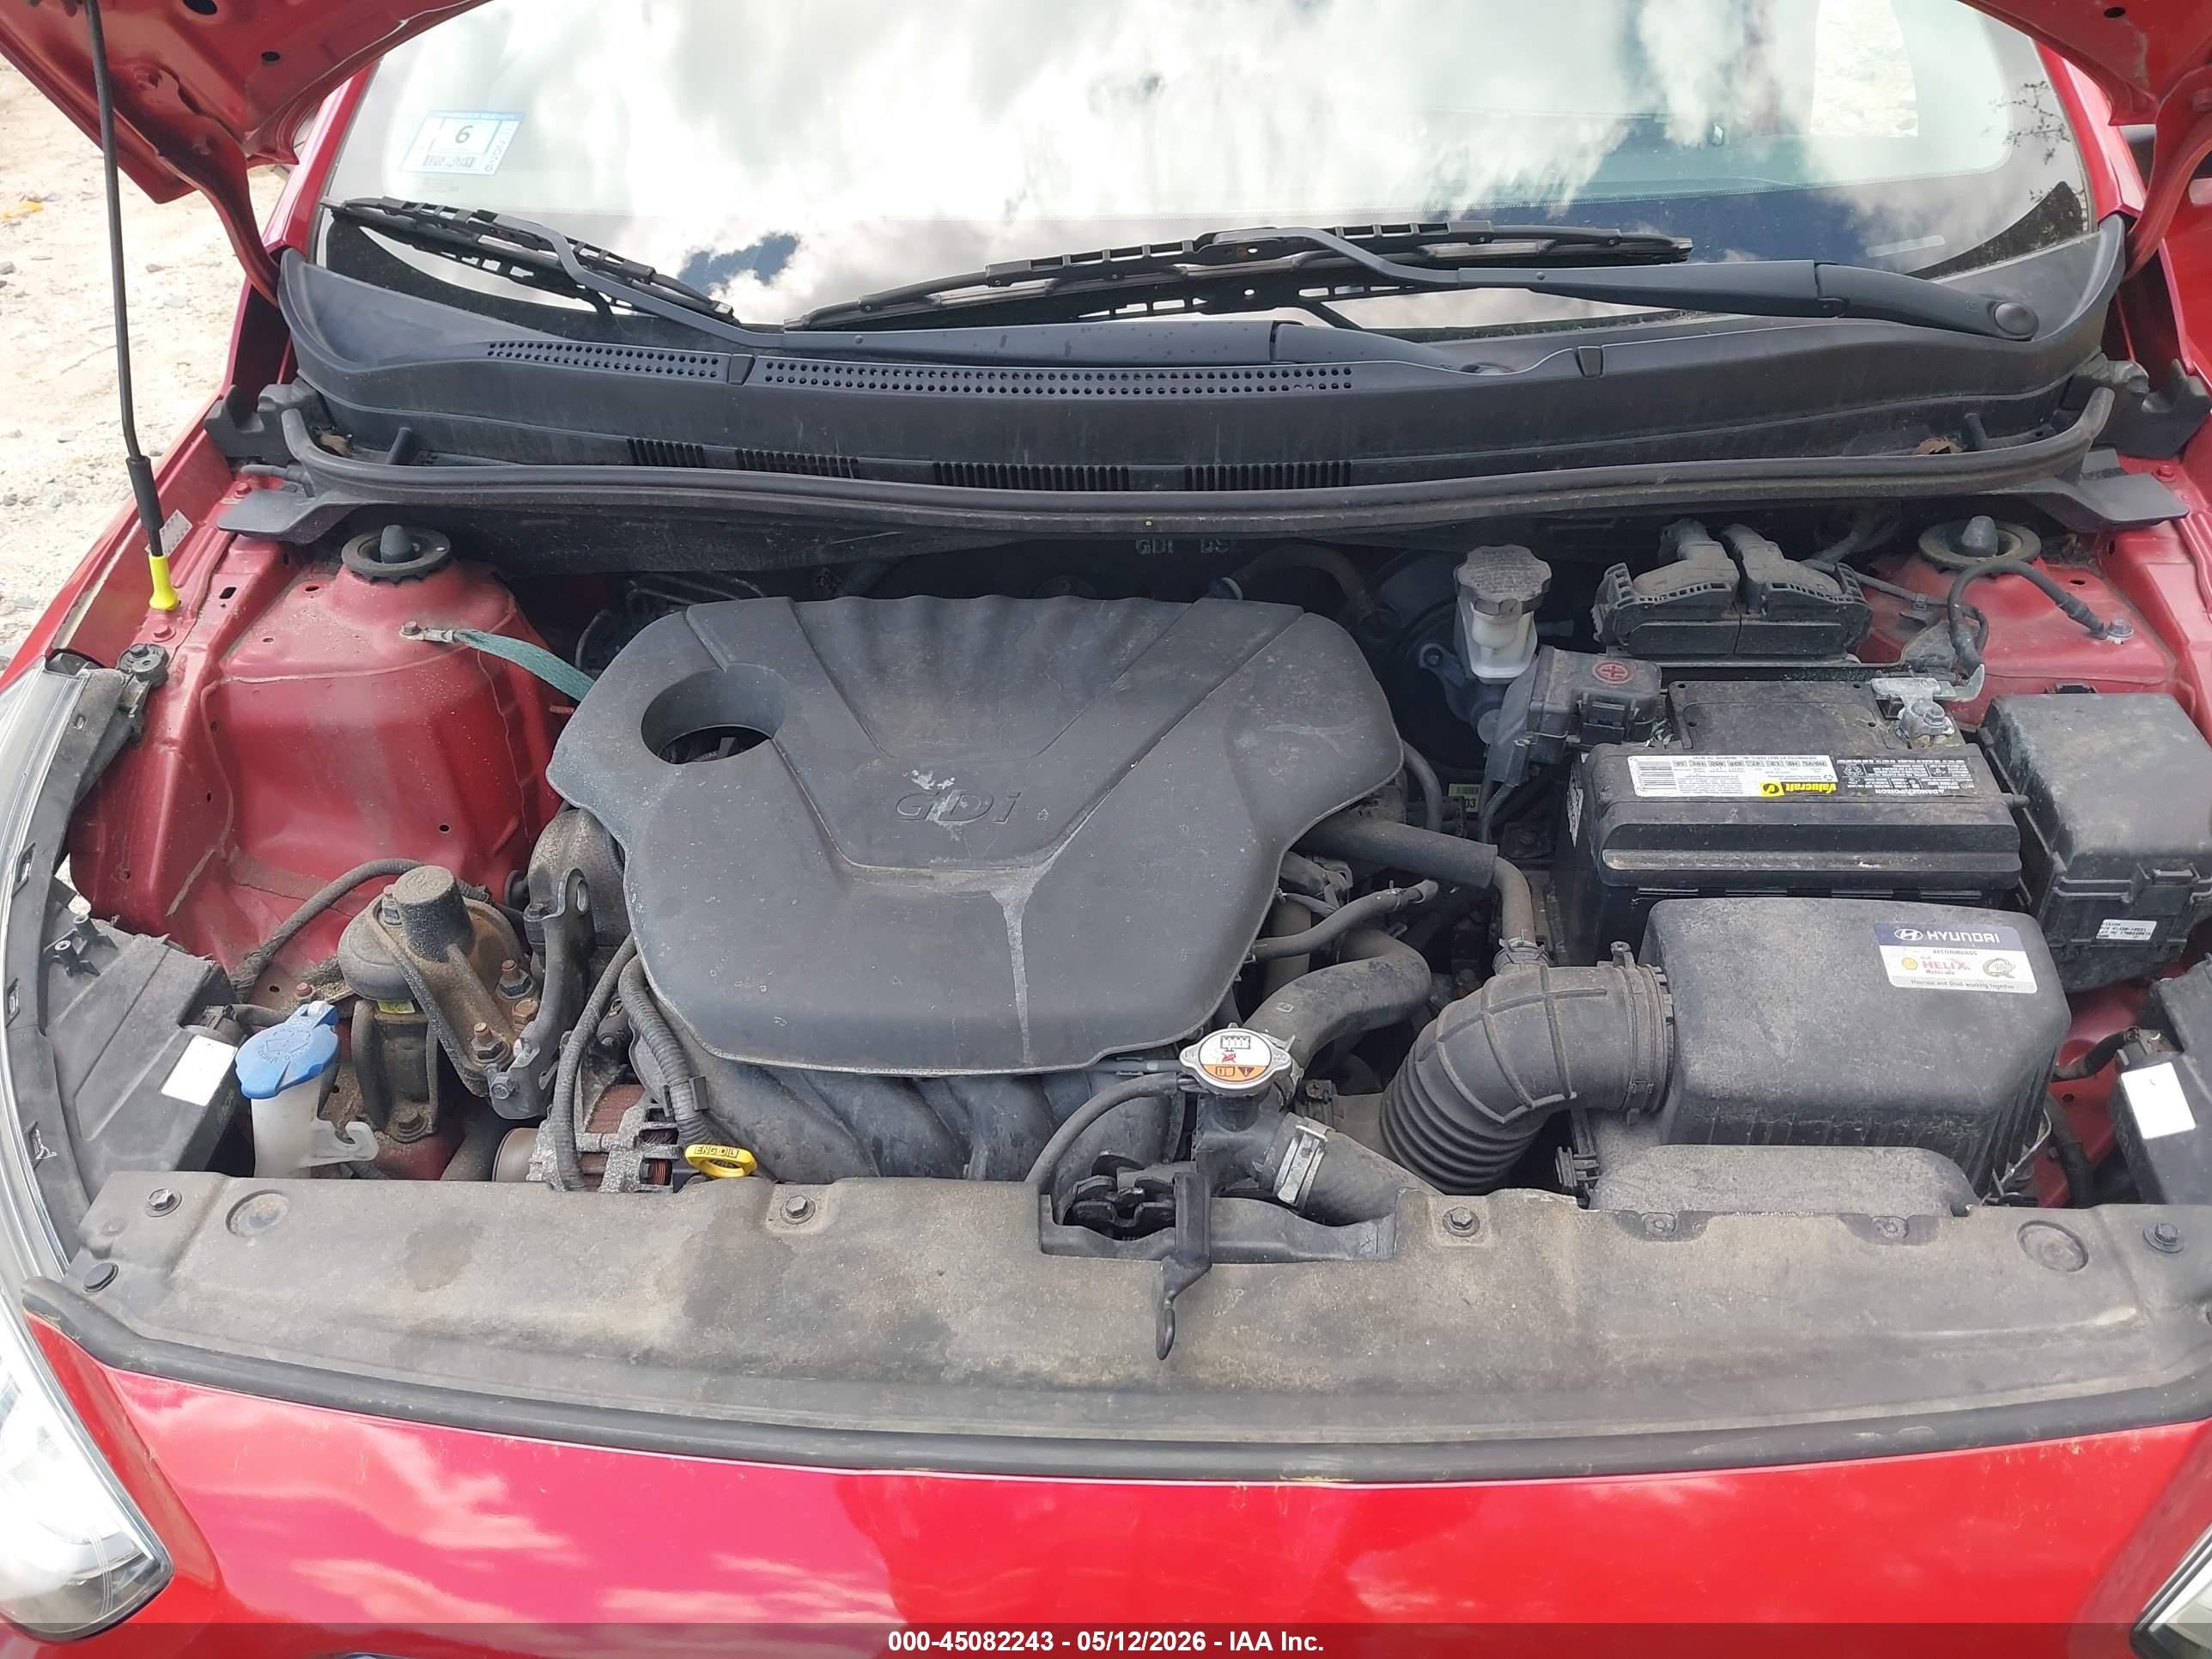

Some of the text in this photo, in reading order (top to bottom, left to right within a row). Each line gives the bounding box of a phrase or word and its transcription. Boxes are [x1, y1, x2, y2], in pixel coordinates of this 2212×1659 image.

[1786, 782, 1837, 793] Valucraft
[1927, 931, 2000, 943] HYUNDAI
[1922, 960, 1970, 970] HELIX
[695, 1146, 739, 1158] ENG OIL
